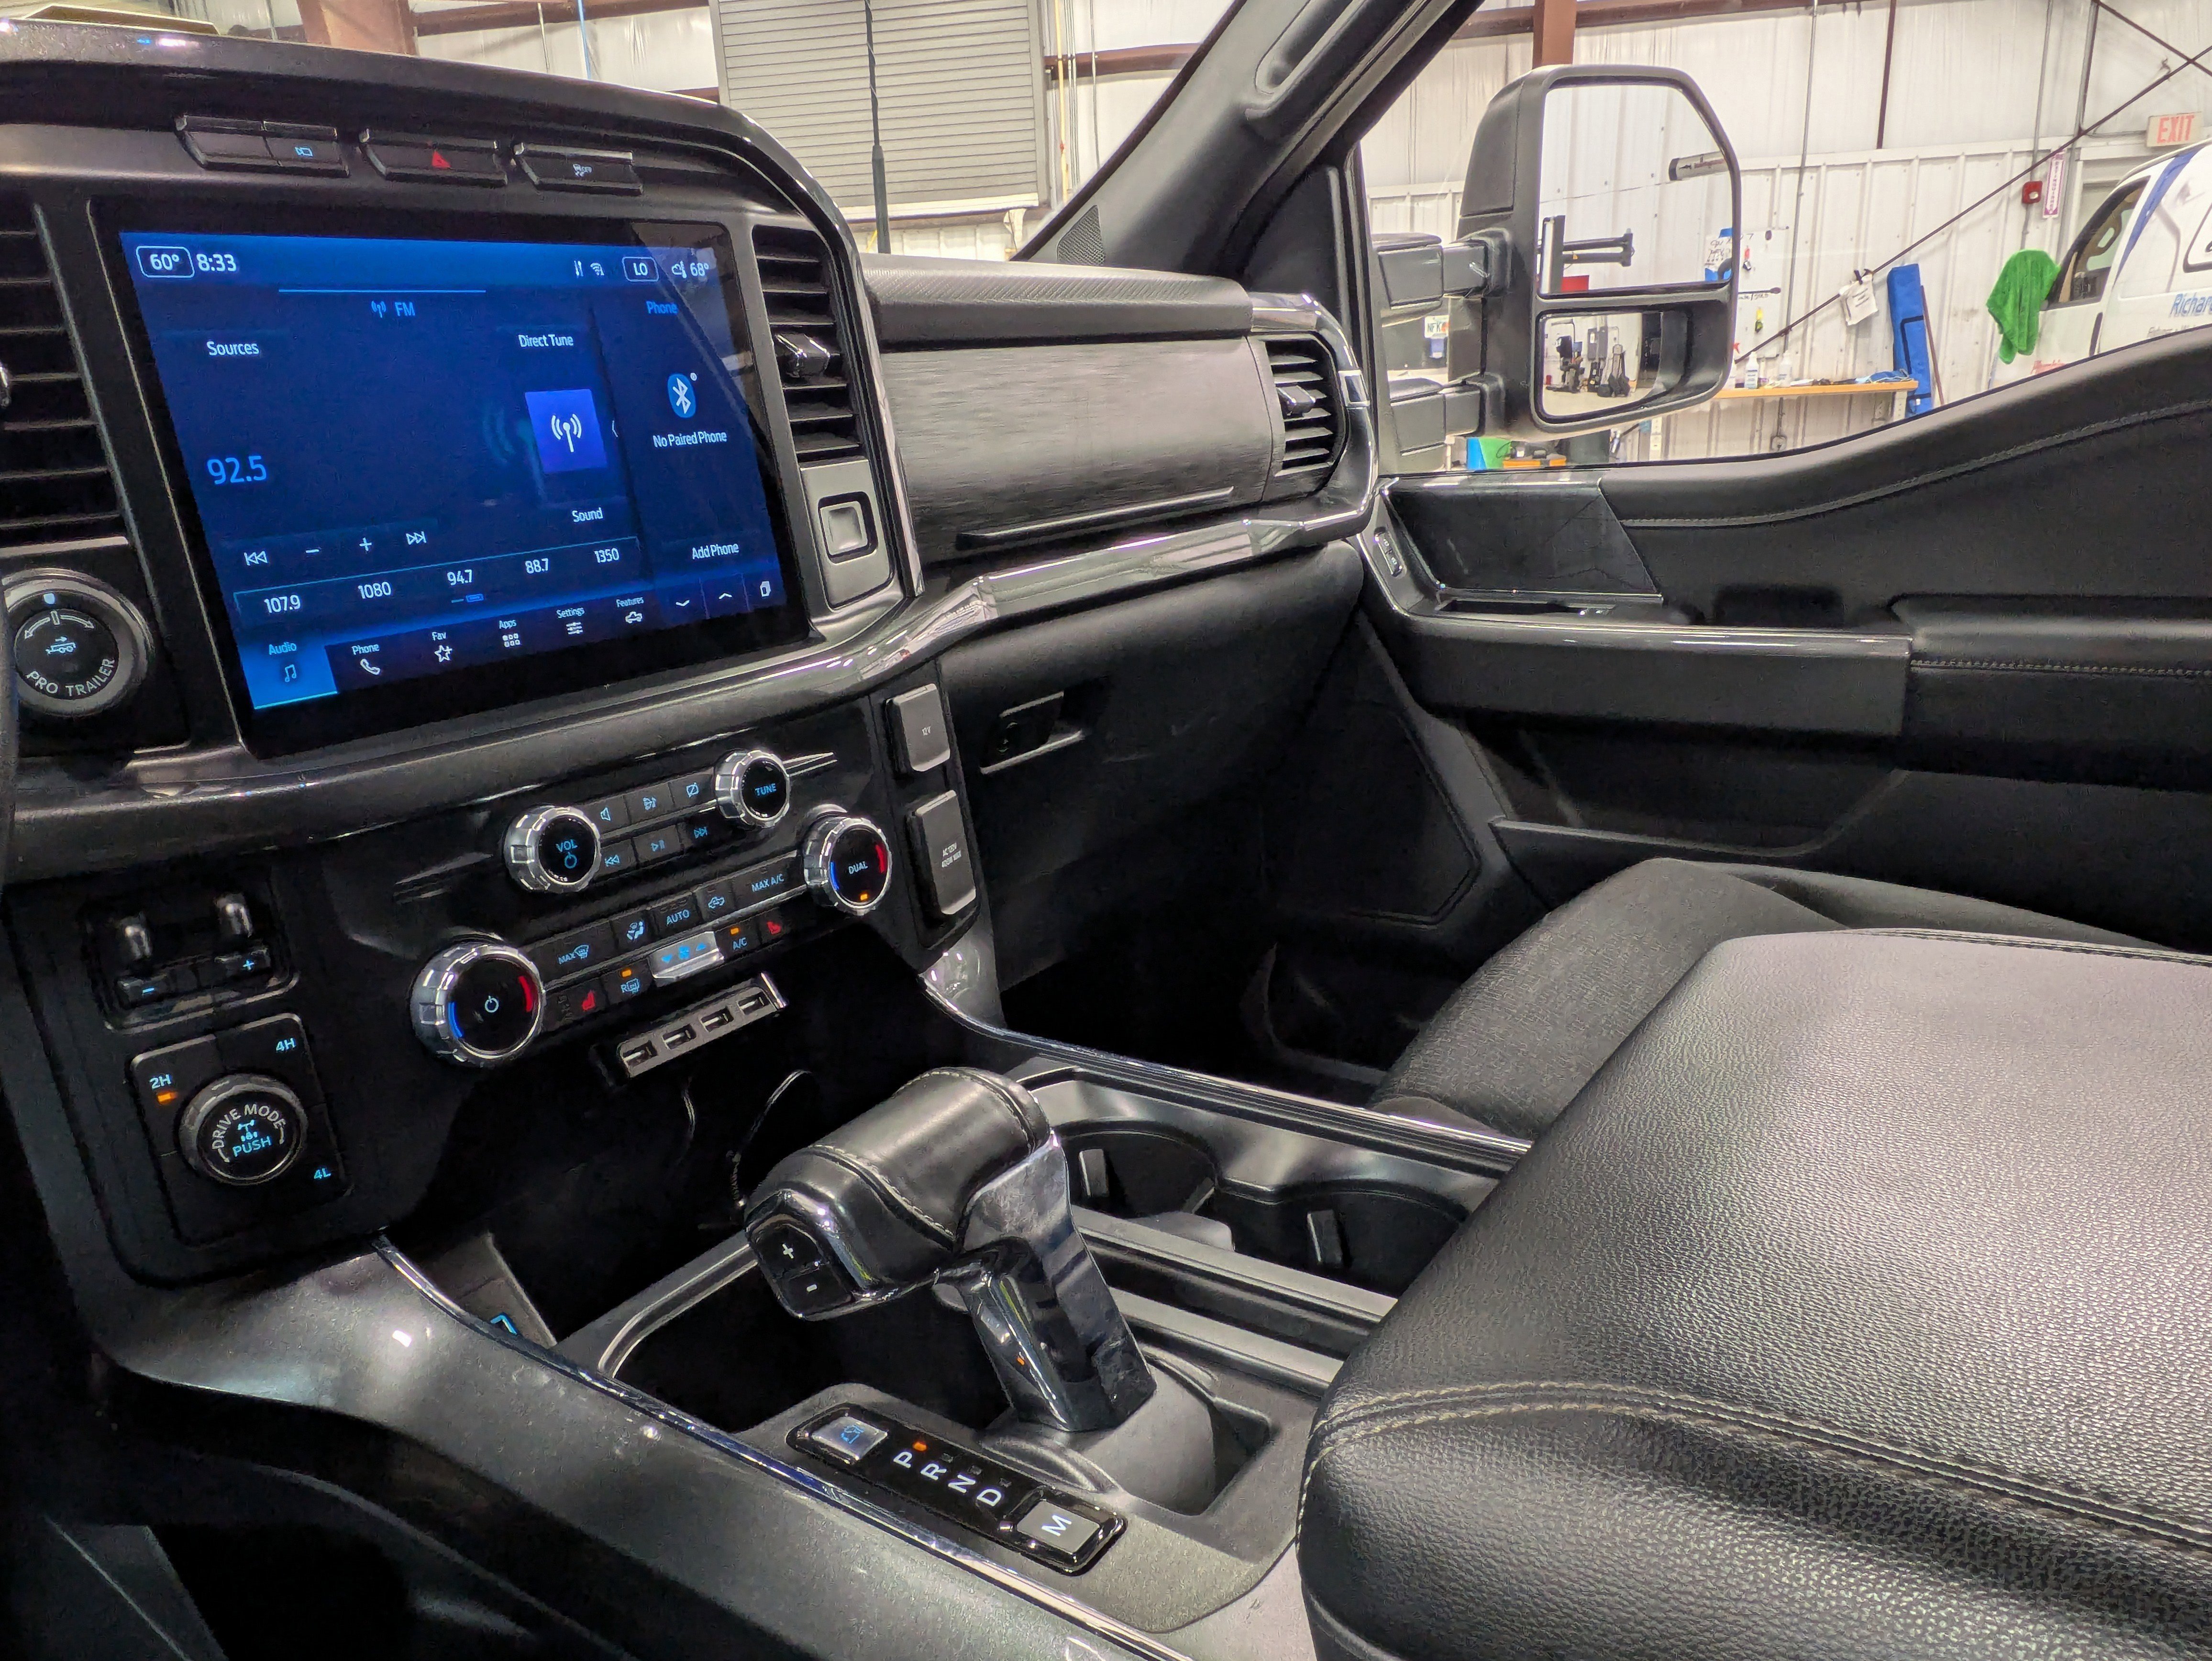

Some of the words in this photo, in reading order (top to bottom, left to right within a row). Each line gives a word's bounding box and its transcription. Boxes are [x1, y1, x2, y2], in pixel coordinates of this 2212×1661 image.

[2157, 115, 2195, 143] EXIT
[150, 254, 180, 270] 60°
[196, 254, 236, 272] 8:33
[395, 302, 415, 317] FM
[646, 301, 678, 314] Phone
[207, 341, 259, 356] Sources
[518, 334, 549, 347] Direct
[548, 334, 574, 346] Tune
[653, 434, 668, 448] No
[668, 433, 698, 446] Paired
[698, 431, 727, 444] Phone
[207, 455, 268, 485] 92.5
[572, 507, 604, 523] Sound
[595, 548, 620, 564] 1350
[692, 546, 710, 560] Add
[710, 542, 740, 557] Phone
[525, 558, 549, 574] 88.7
[447, 569, 473, 586] 94.7
[358, 581, 391, 599] 1080
[264, 595, 301, 613] 107.9
[616, 597, 644, 608] Features
[556, 606, 586, 619] Settings
[499, 620, 517, 629] Apps
[431, 631, 446, 641] Fav
[268, 642, 297, 656] Audio
[352, 643, 380, 655] Phone
[26, 671, 58, 694] PRO
[65, 658, 115, 697] TRAILER
[754, 783, 777, 795] TUNE
[556, 839, 578, 853] VOL
[848, 862, 869, 875] DUAL
[752, 879, 770, 892] MAX
[770, 873, 785, 886] A/C
[666, 909, 690, 925] AUTO
[733, 937, 748, 950] A/C
[558, 951, 576, 965] MAX
[276, 1037, 297, 1053] 4H
[149, 1074, 173, 1089] 2H
[212, 1108, 242, 1151] DRIVE
[243, 1104, 286, 1129] MODE
[232, 1135, 272, 1157] PUSH
[313, 1167, 331, 1180] 4L
[893, 1451, 914, 1469] P
[920, 1462, 948, 1481] R
[947, 1474, 977, 1495] N
[976, 1488, 1003, 1507] D
[1041, 1514, 1073, 1536] M
